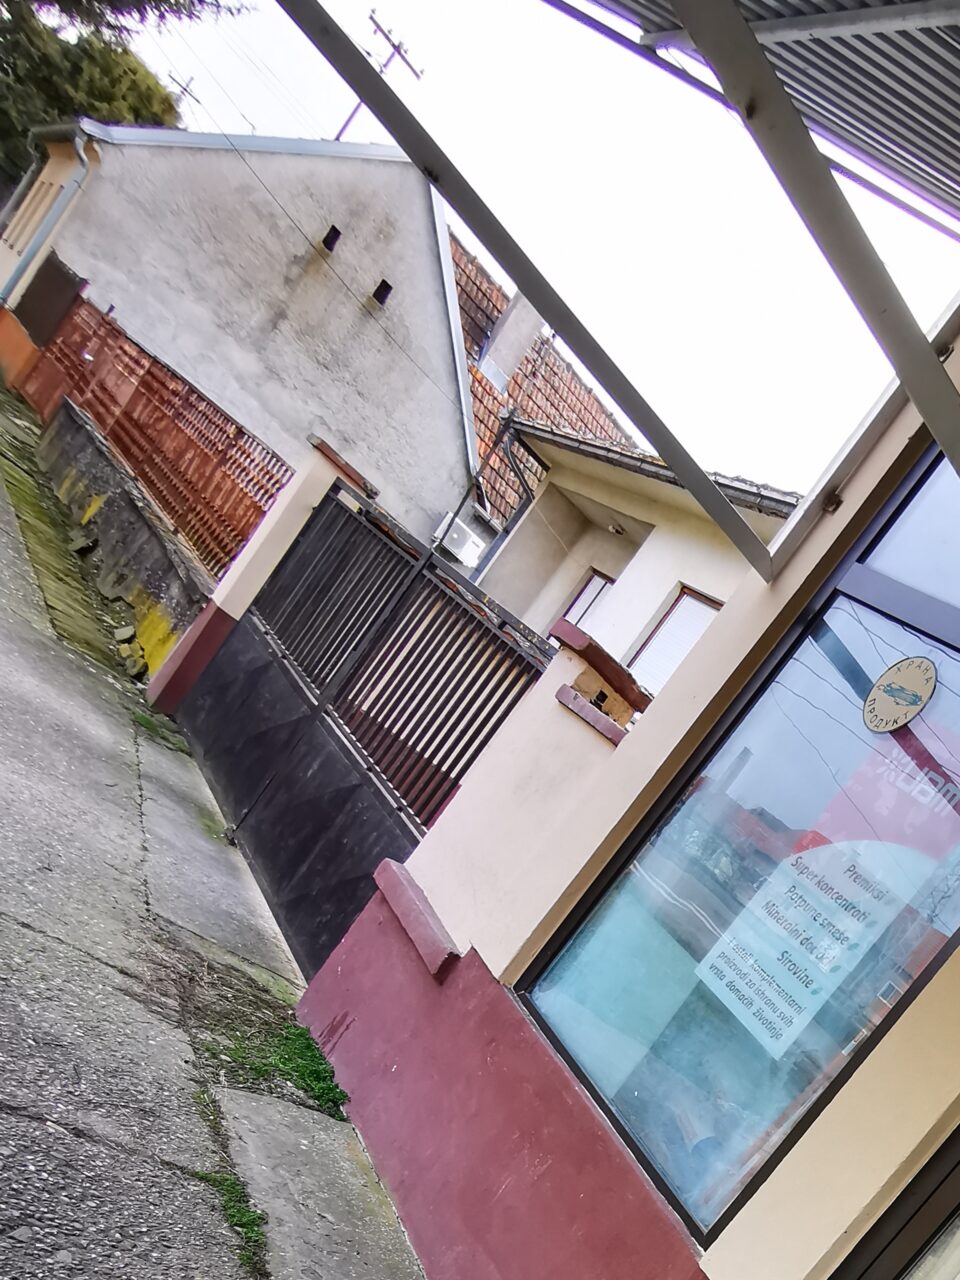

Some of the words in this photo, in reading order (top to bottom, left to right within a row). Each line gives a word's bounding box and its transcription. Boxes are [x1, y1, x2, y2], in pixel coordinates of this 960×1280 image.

[894, 659, 934, 686] ХРАНА
[867, 697, 910, 728] ПРОДУКТ
[790, 856, 818, 882] Super
[814, 877, 871, 923] koncentrati
[844, 864, 889, 902] Premiksi
[762, 900, 806, 942] Mineralni
[785, 885, 820, 922] Potpune
[708, 963, 726, 981] vrsta
[732, 942, 752, 962] ostali
[750, 958, 807, 1015] komplementarni
[777, 950, 815, 989] Sirovine
[718, 951, 751, 985] proizvodi
[746, 978, 756, 989] za
[753, 986, 781, 1017] ishranu
[779, 1010, 794, 1028] svih
